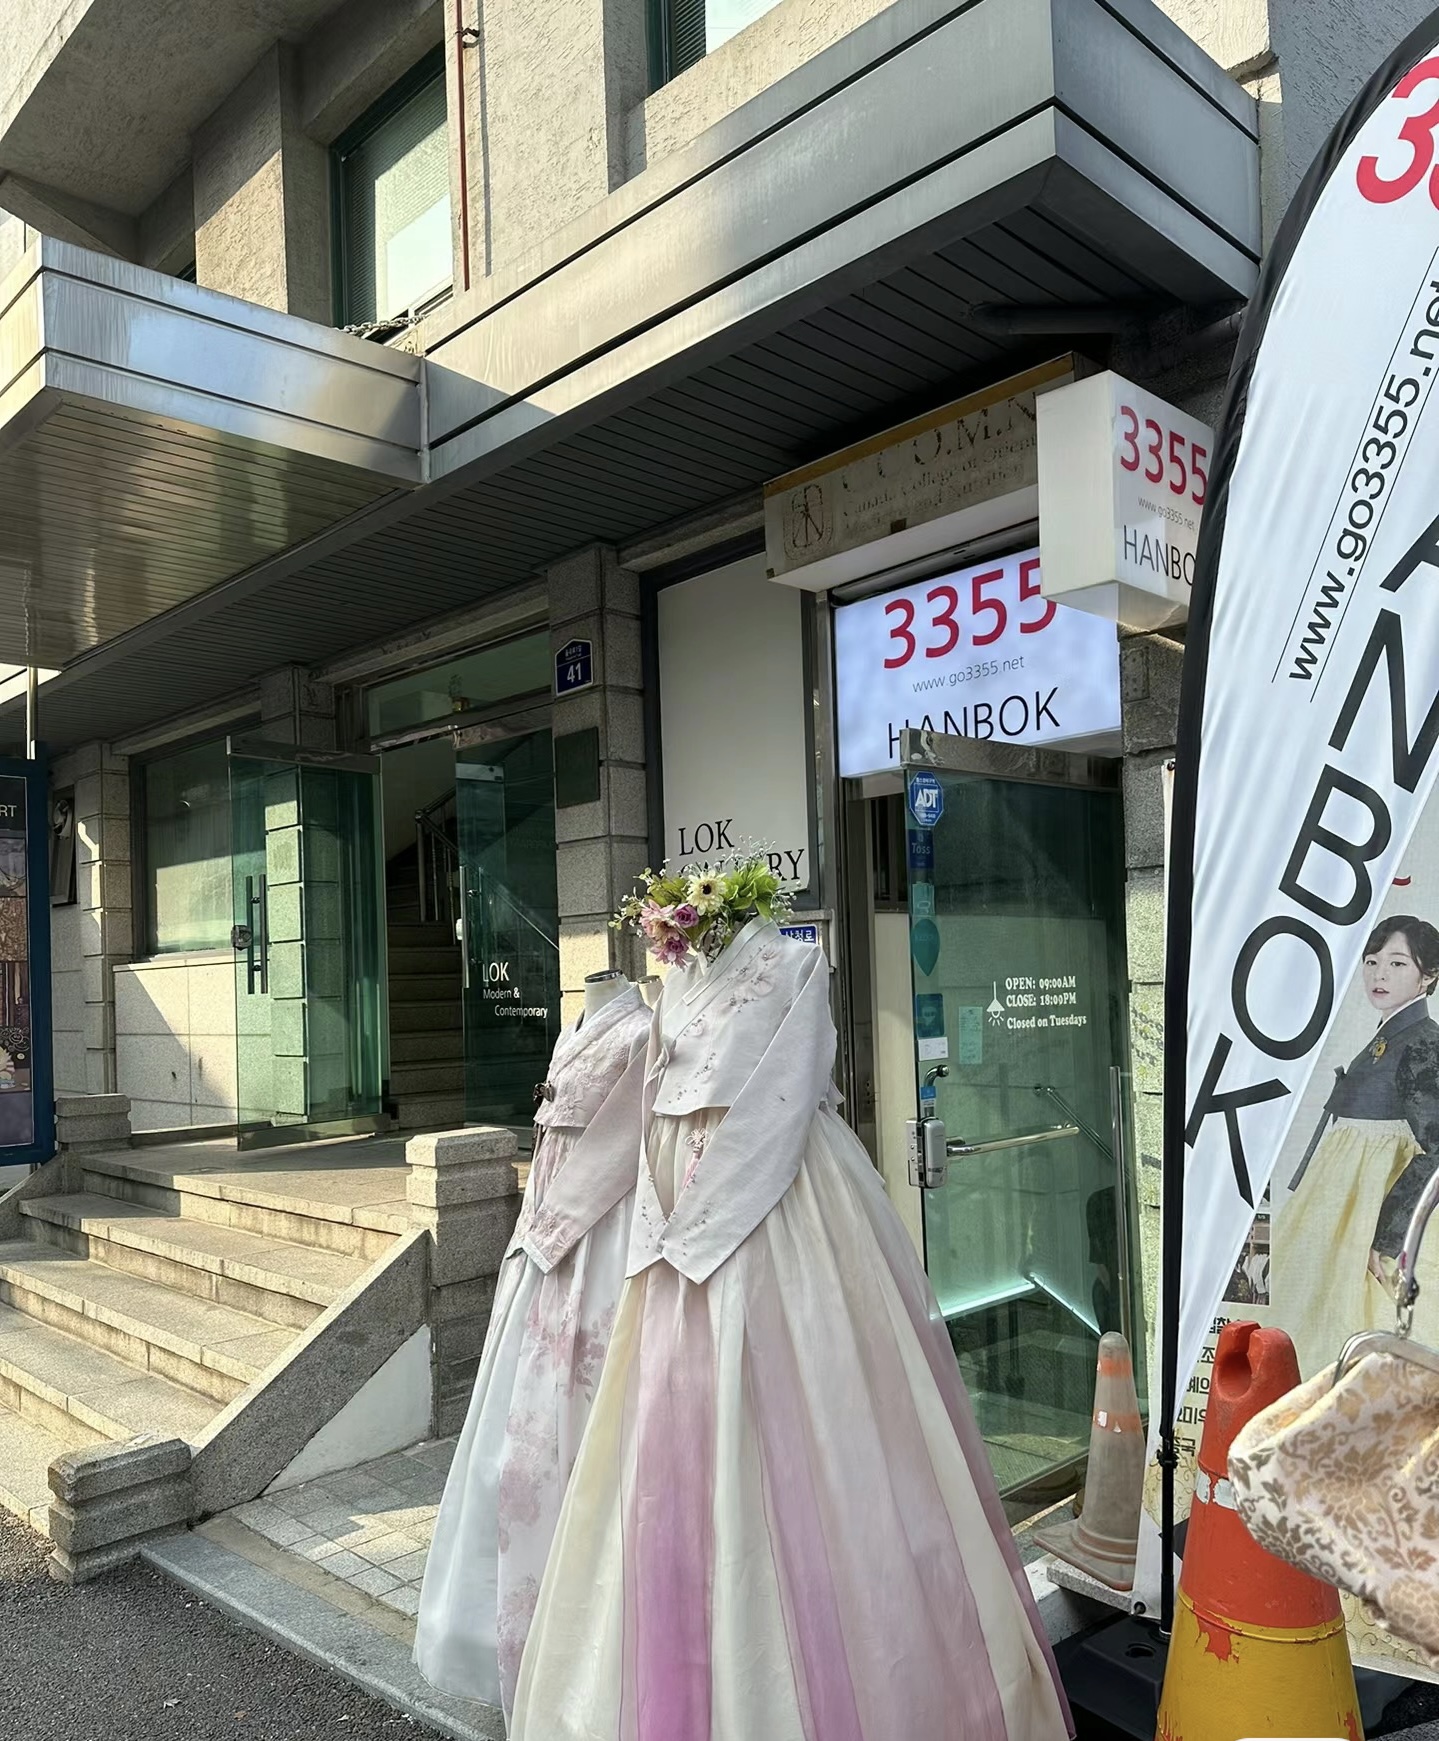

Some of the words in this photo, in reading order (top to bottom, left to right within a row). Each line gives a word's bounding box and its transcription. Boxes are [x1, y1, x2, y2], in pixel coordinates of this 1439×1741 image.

[1120, 405, 1207, 505] 3355
[884, 558, 1057, 669] 3355
[566, 662, 582, 683] 41
[912, 656, 1025, 693] www.go3355.net
[915, 788, 938, 808] ADT
[678, 819, 734, 856] LOK
[483, 962, 509, 982] LOK
[483, 988, 512, 999] Modern
[513, 987, 520, 999] &
[1005, 977, 1036, 990] OPEN:
[1039, 976, 1076, 990] 09:00AM
[1006, 994, 1037, 1007] CLOSE:
[1039, 992, 1077, 1006] 18:00PM
[495, 1005, 548, 1019] Contemporary
[1007, 1017, 1036, 1029] Closed
[1037, 1019, 1048, 1027] on
[1049, 1014, 1087, 1026] Tuesdays
